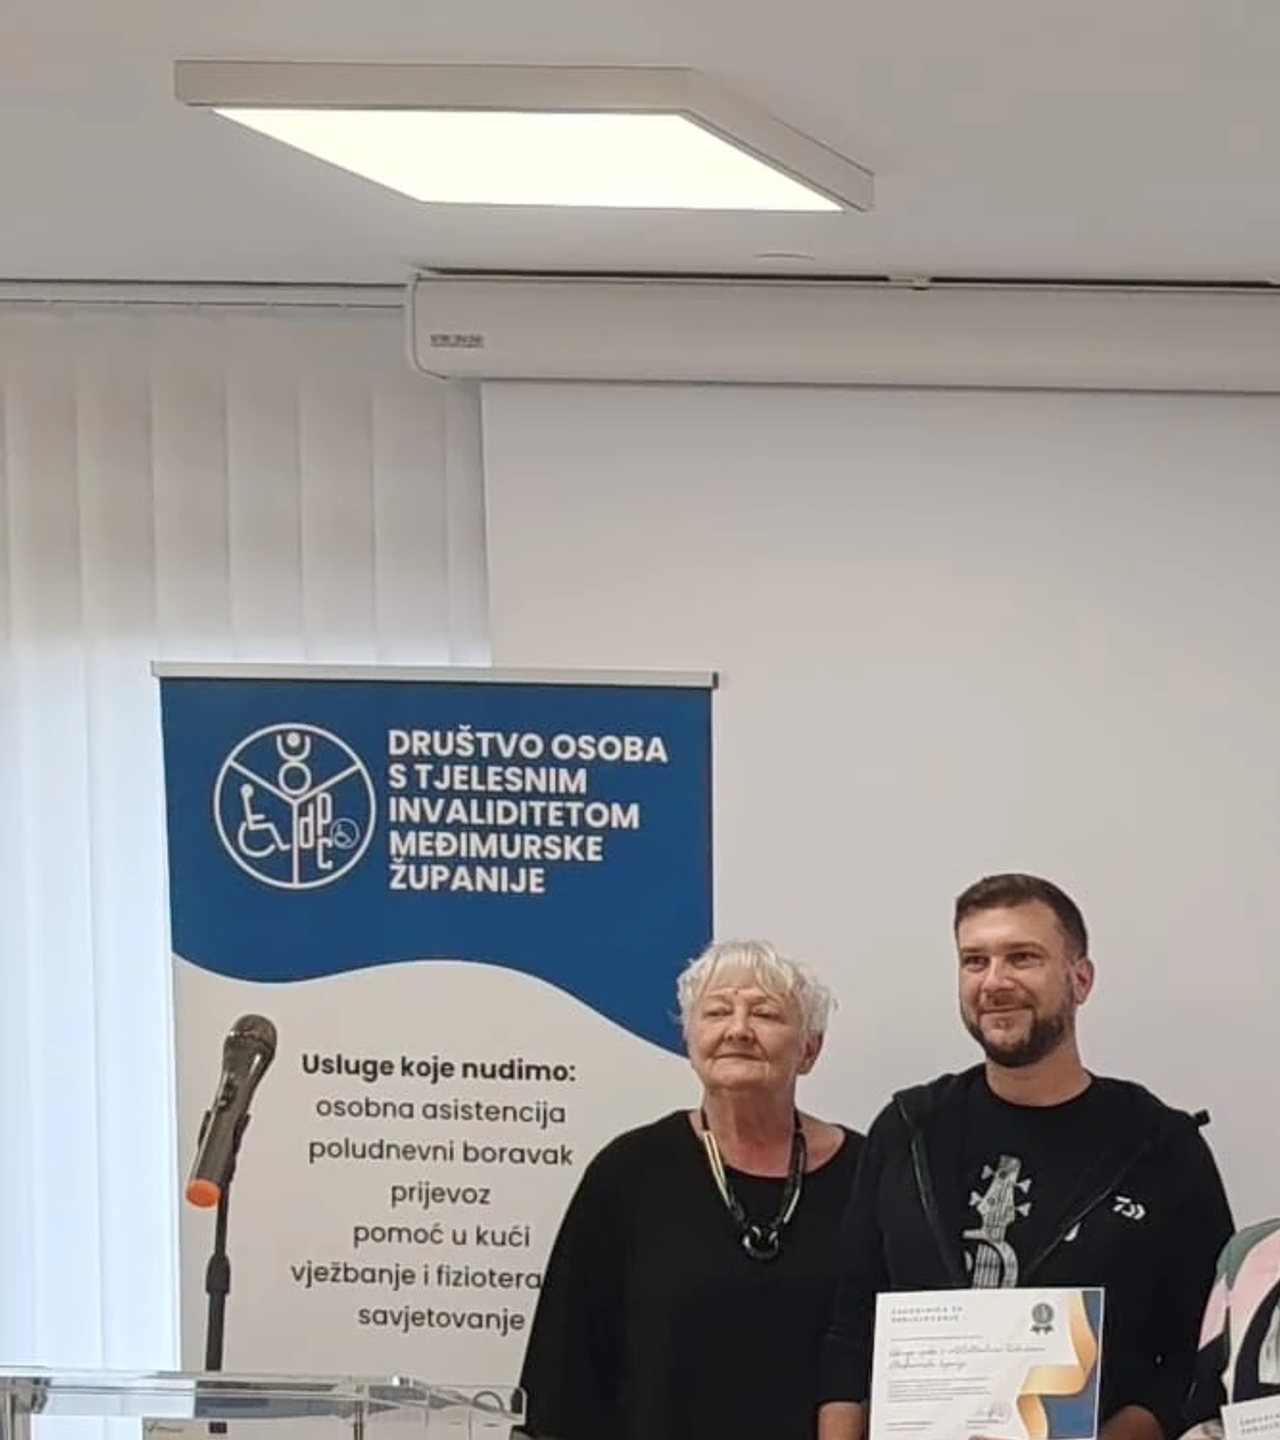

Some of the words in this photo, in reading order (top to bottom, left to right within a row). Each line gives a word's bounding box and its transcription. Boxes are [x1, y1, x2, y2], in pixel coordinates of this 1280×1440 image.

[388, 724, 544, 760] DRUŠTVO
[551, 732, 669, 763] OSOBA
[388, 764, 407, 790] S
[417, 766, 587, 795] TJELESNIM
[388, 797, 640, 830] INVALIDITETOM
[389, 831, 604, 862] MEĐIMURSKE
[388, 857, 546, 894] ŽUPANIJE
[301, 1053, 395, 1083] Usluge
[400, 1054, 455, 1085] koje
[461, 1058, 577, 1083] nudimo:
[316, 1096, 415, 1120] osobna
[421, 1099, 567, 1129] asistencija
[308, 1137, 455, 1164] poludnevni
[462, 1141, 574, 1166] boravak
[390, 1179, 491, 1210] prijevoz
[352, 1221, 444, 1249] pomoć
[452, 1227, 468, 1247] u
[476, 1222, 531, 1248] kući
[291, 1260, 416, 1291] vježbanje
[422, 1264, 430, 1286] i
[357, 1304, 526, 1337] savjetovanje
